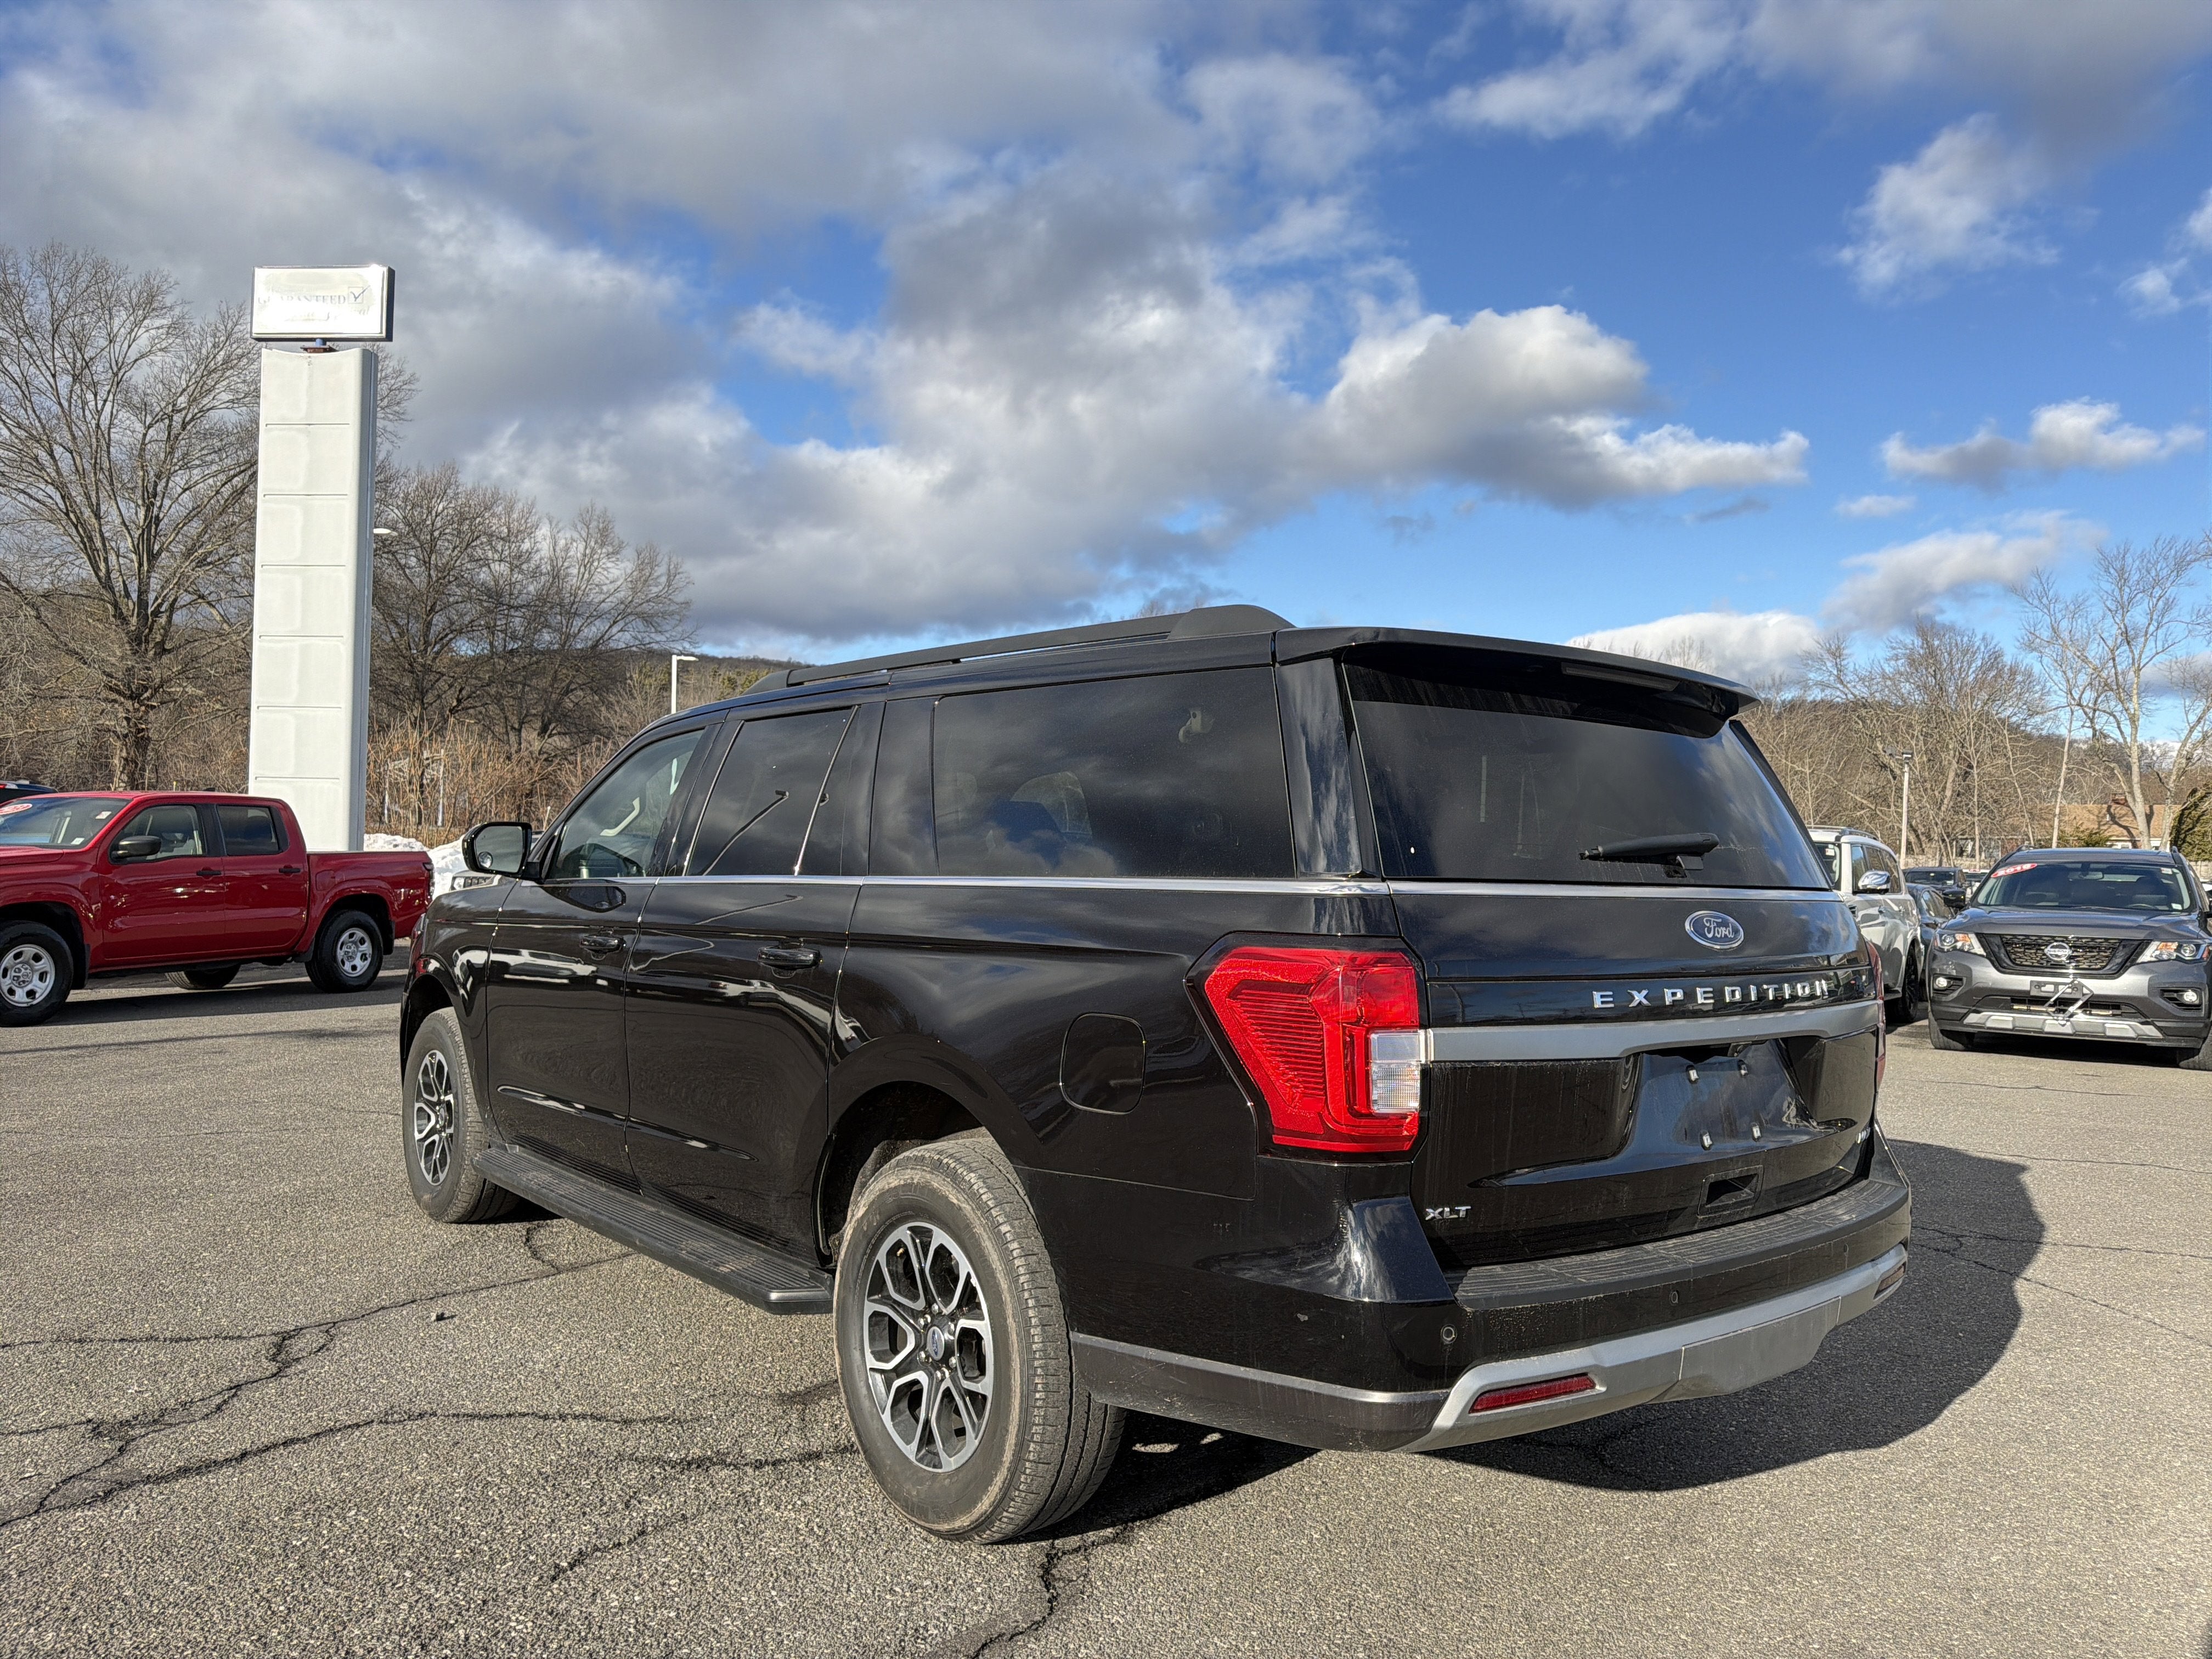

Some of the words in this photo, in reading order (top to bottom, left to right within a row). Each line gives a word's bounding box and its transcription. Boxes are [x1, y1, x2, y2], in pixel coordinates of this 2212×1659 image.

[1703, 918, 1734, 938] Ford
[1593, 979, 1829, 1008] EXPEDITION
[1425, 1206, 1471, 1220] XLT
